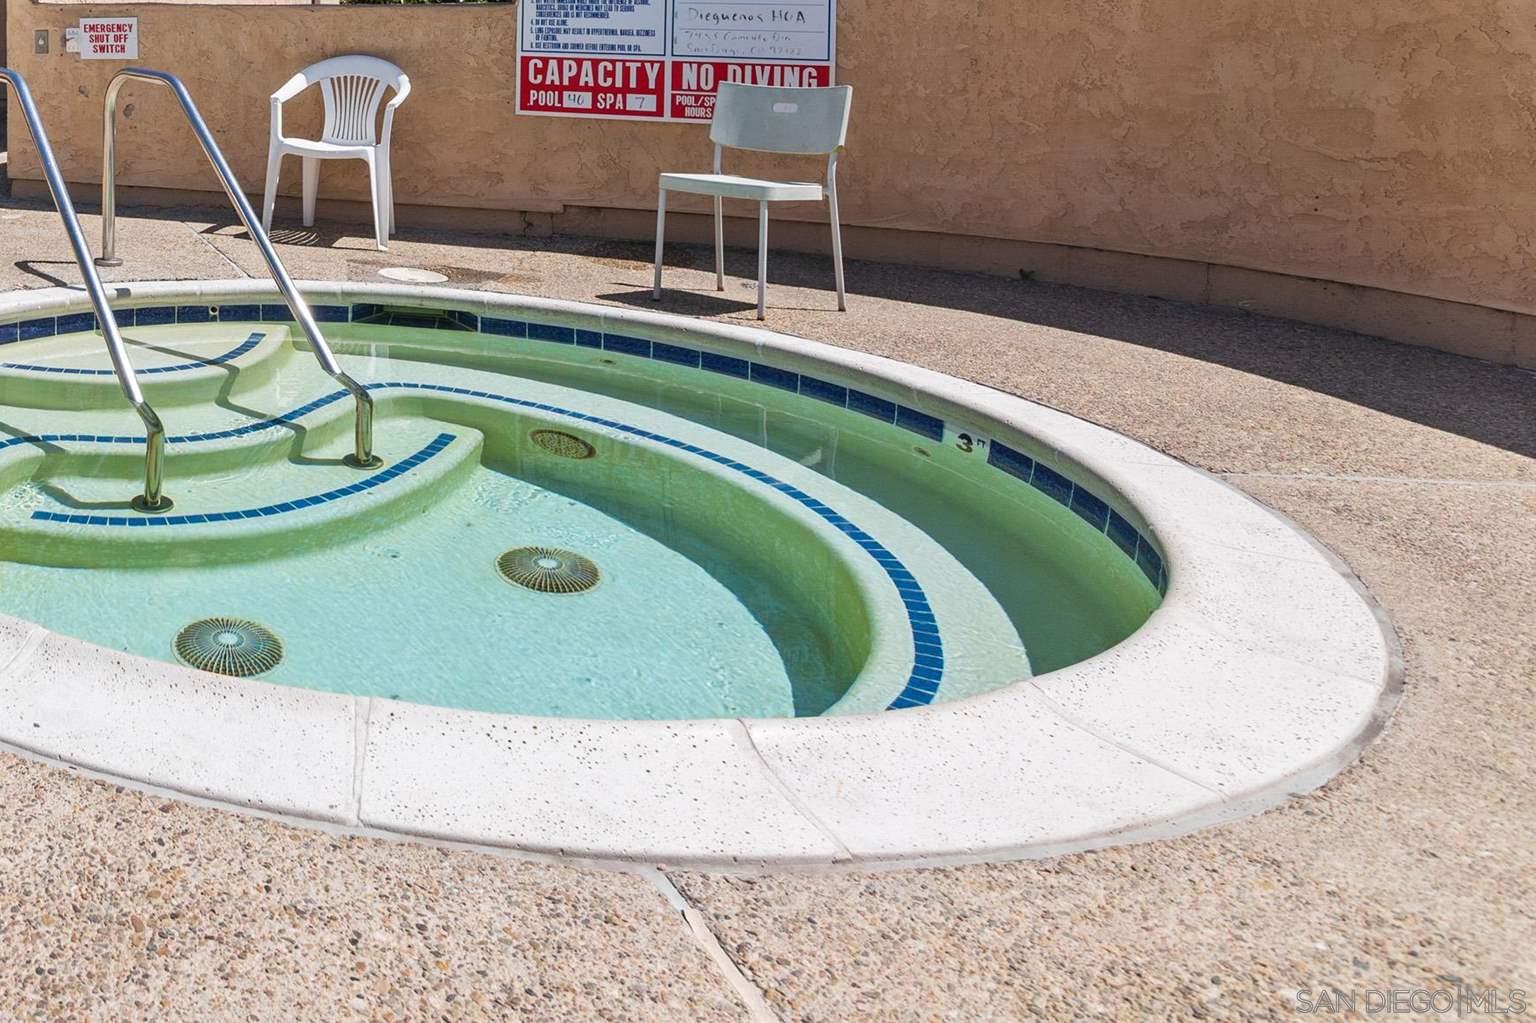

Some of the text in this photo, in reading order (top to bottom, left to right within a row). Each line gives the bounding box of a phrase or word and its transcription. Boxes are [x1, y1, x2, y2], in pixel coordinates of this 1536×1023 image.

[83, 23, 133, 33] EMERGENCY
[89, 33, 110, 43] SHUT
[113, 33, 129, 43] OFF
[92, 44, 126, 53] SWITCH
[528, 58, 661, 89] CAPACITY
[682, 62, 817, 91] NO DIVING
[530, 89, 561, 107] POOL
[597, 92, 624, 110] SPA
[675, 95, 716, 107] POOL/SP
[684, 106, 712, 118] HOURS
[955, 433, 973, 453] 3
